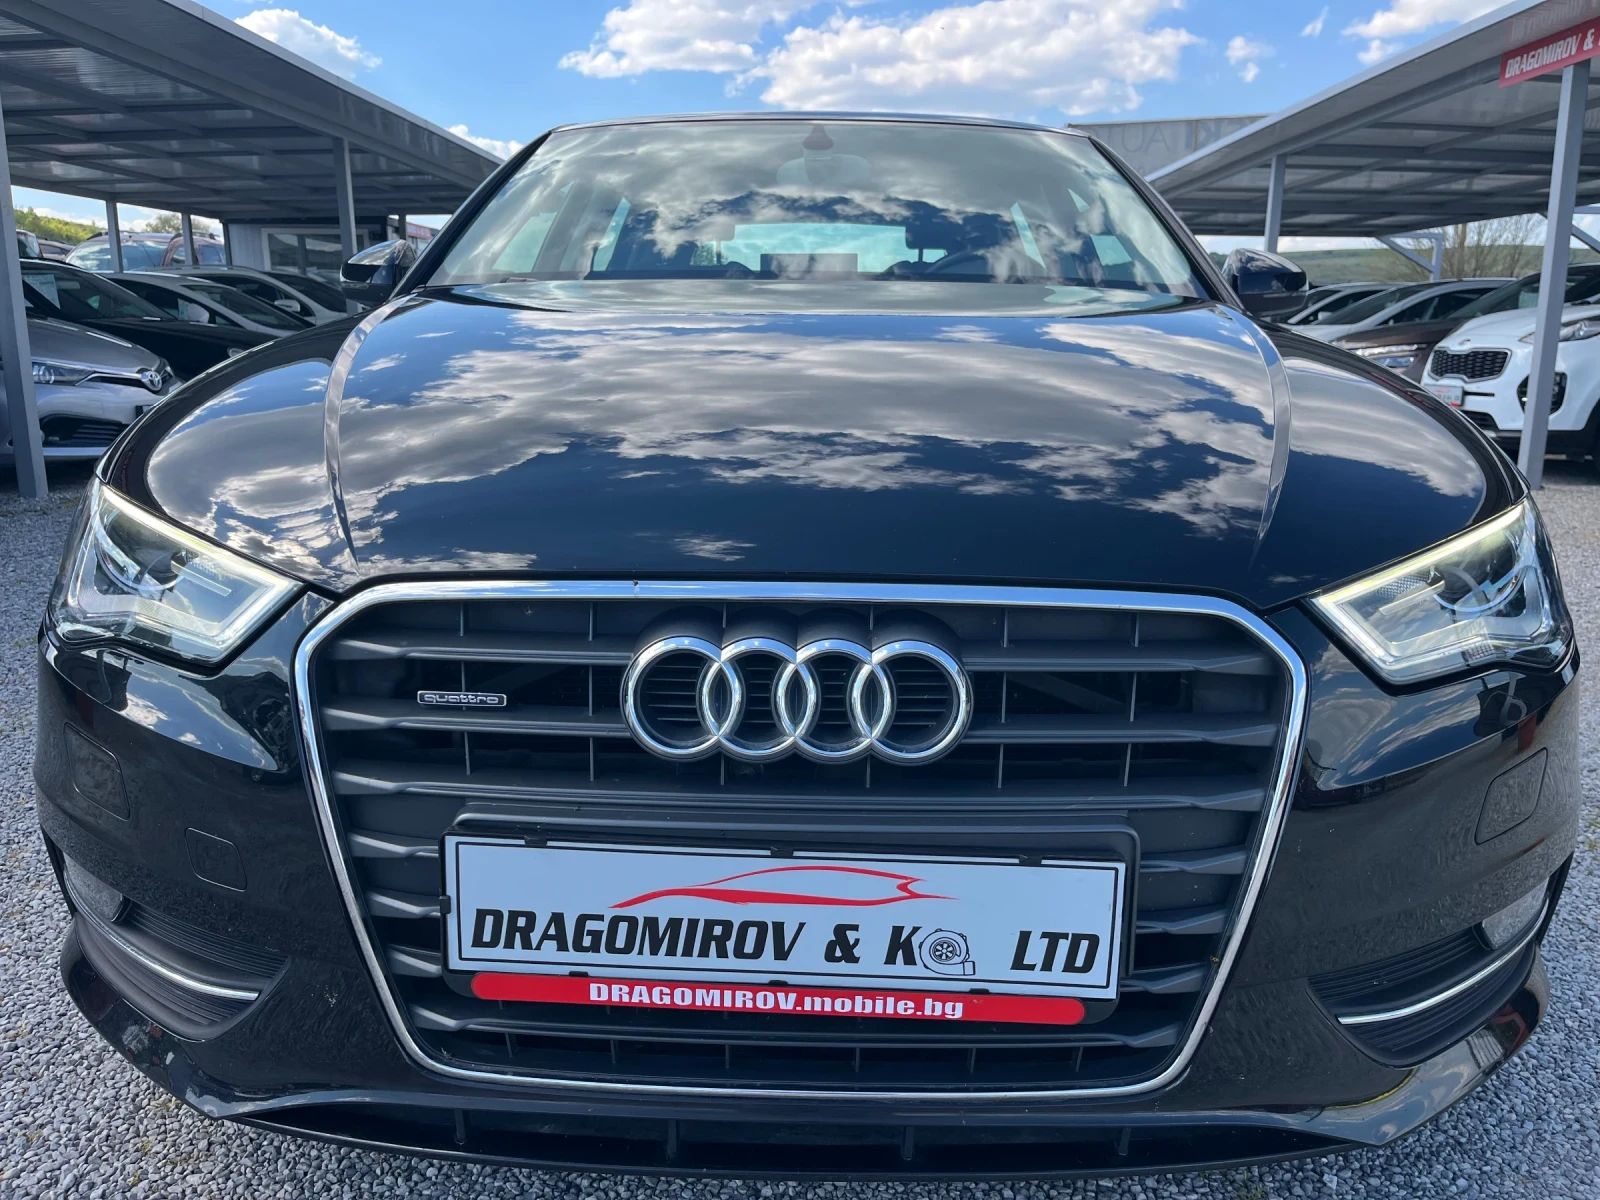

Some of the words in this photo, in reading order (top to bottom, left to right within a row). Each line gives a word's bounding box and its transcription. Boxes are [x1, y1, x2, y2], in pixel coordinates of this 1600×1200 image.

[1505, 33, 1582, 79] DRAGOMIROV
[1583, 28, 1595, 51] &
[423, 694, 499, 704] quattro
[471, 908, 806, 962] DRAGOMIROV
[824, 923, 861, 964] &
[1010, 930, 1101, 974] LTD
[589, 982, 964, 1019] DRAGOMIROV.mobile.bg
